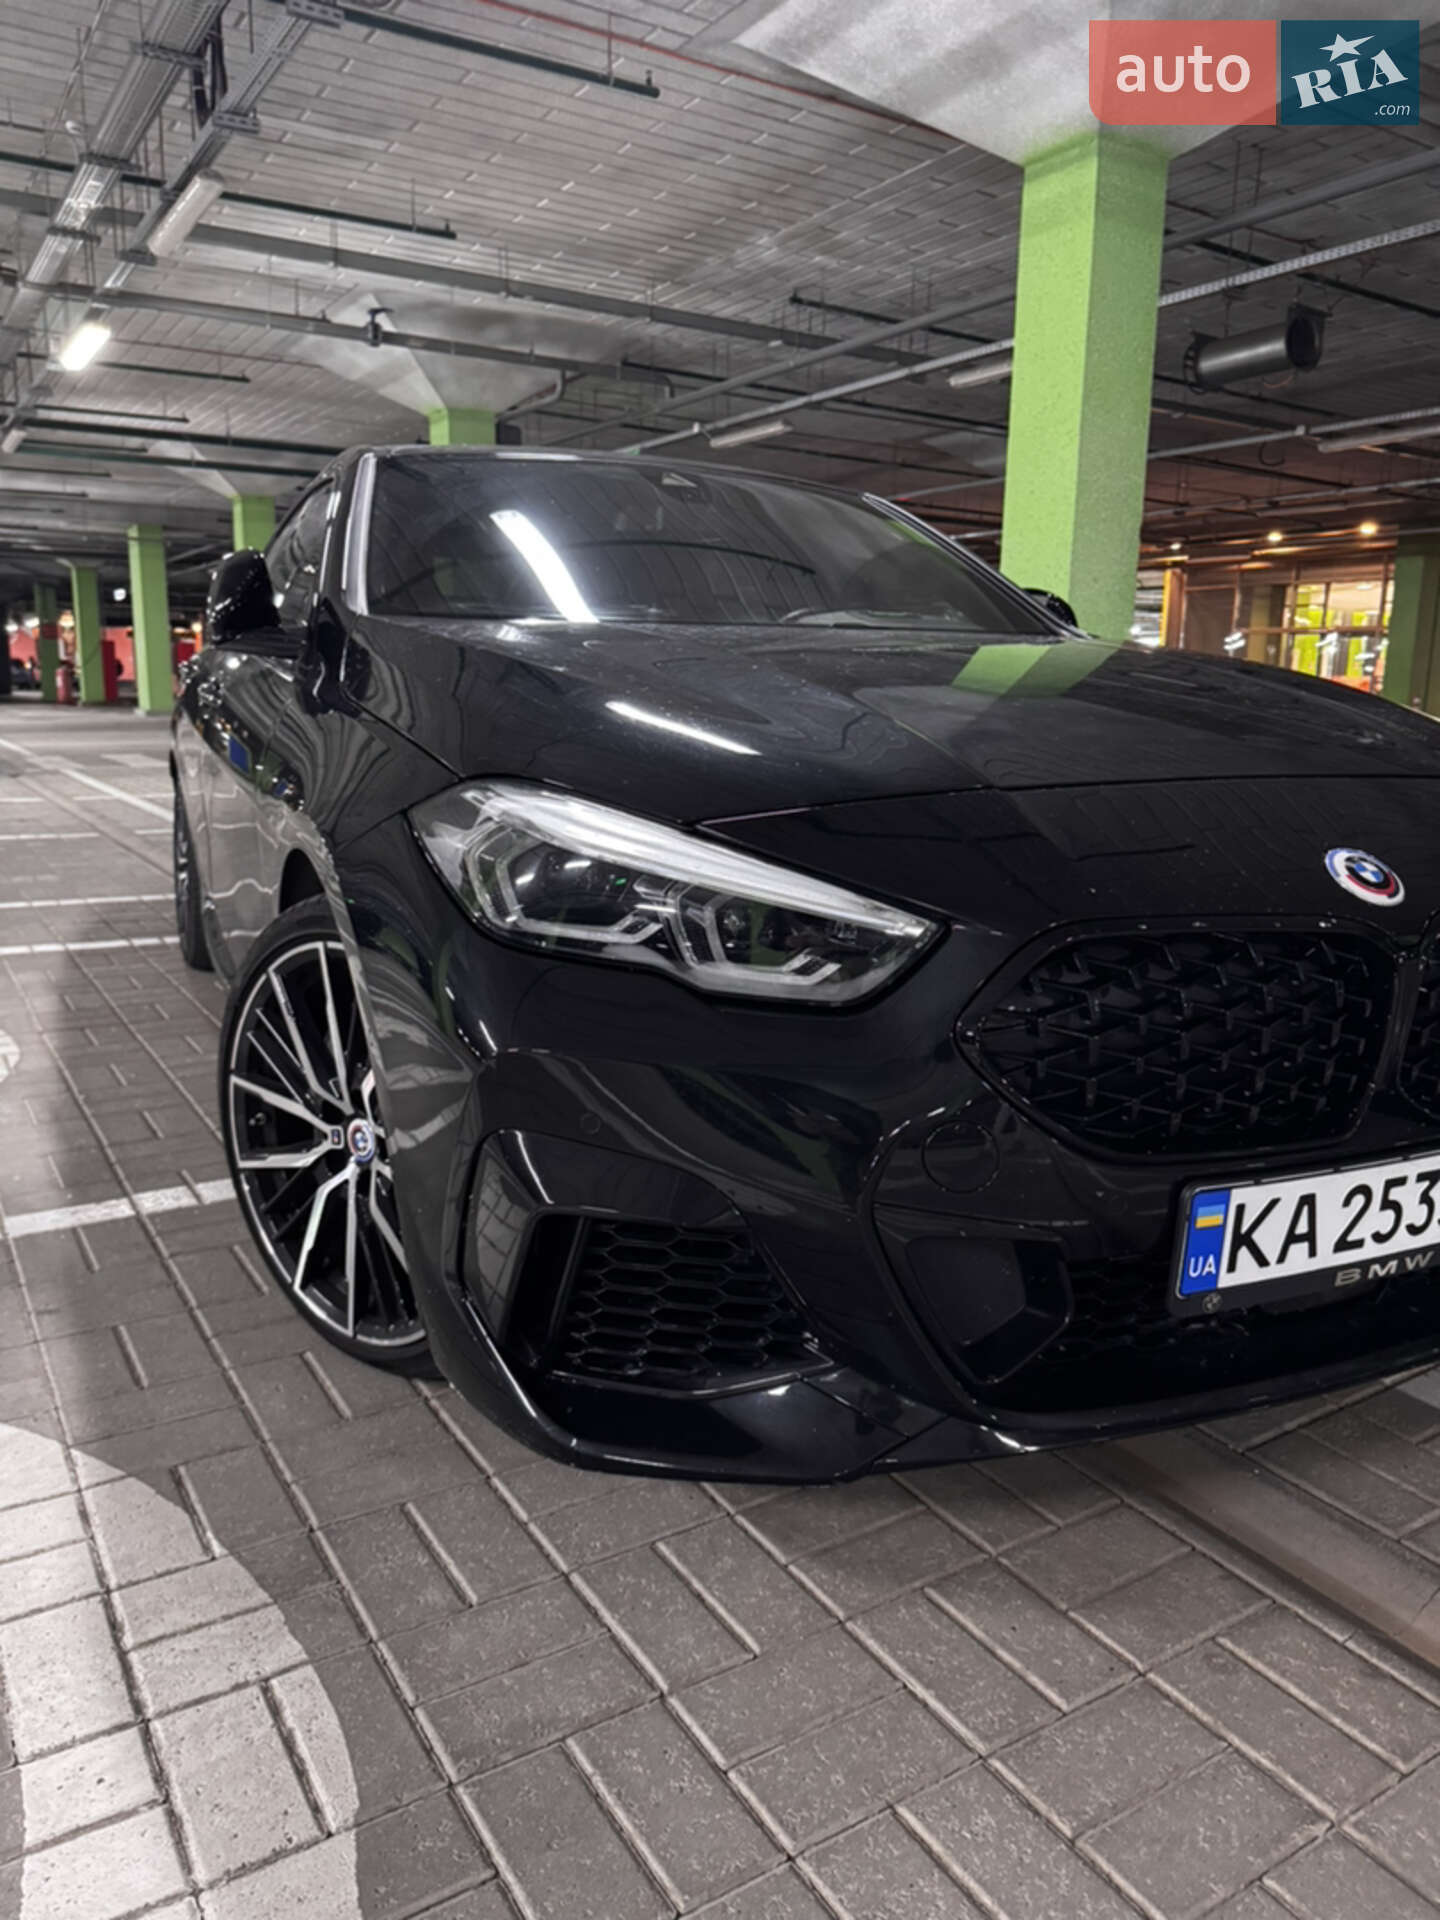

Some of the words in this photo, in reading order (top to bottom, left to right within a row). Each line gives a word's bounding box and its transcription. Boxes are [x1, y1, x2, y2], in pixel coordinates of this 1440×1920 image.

[1226, 1193, 1317, 1274] KA
[1333, 1168, 1440, 1254] 253
[1188, 1253, 1217, 1278] UA
[1334, 1251, 1435, 1287] BMW
